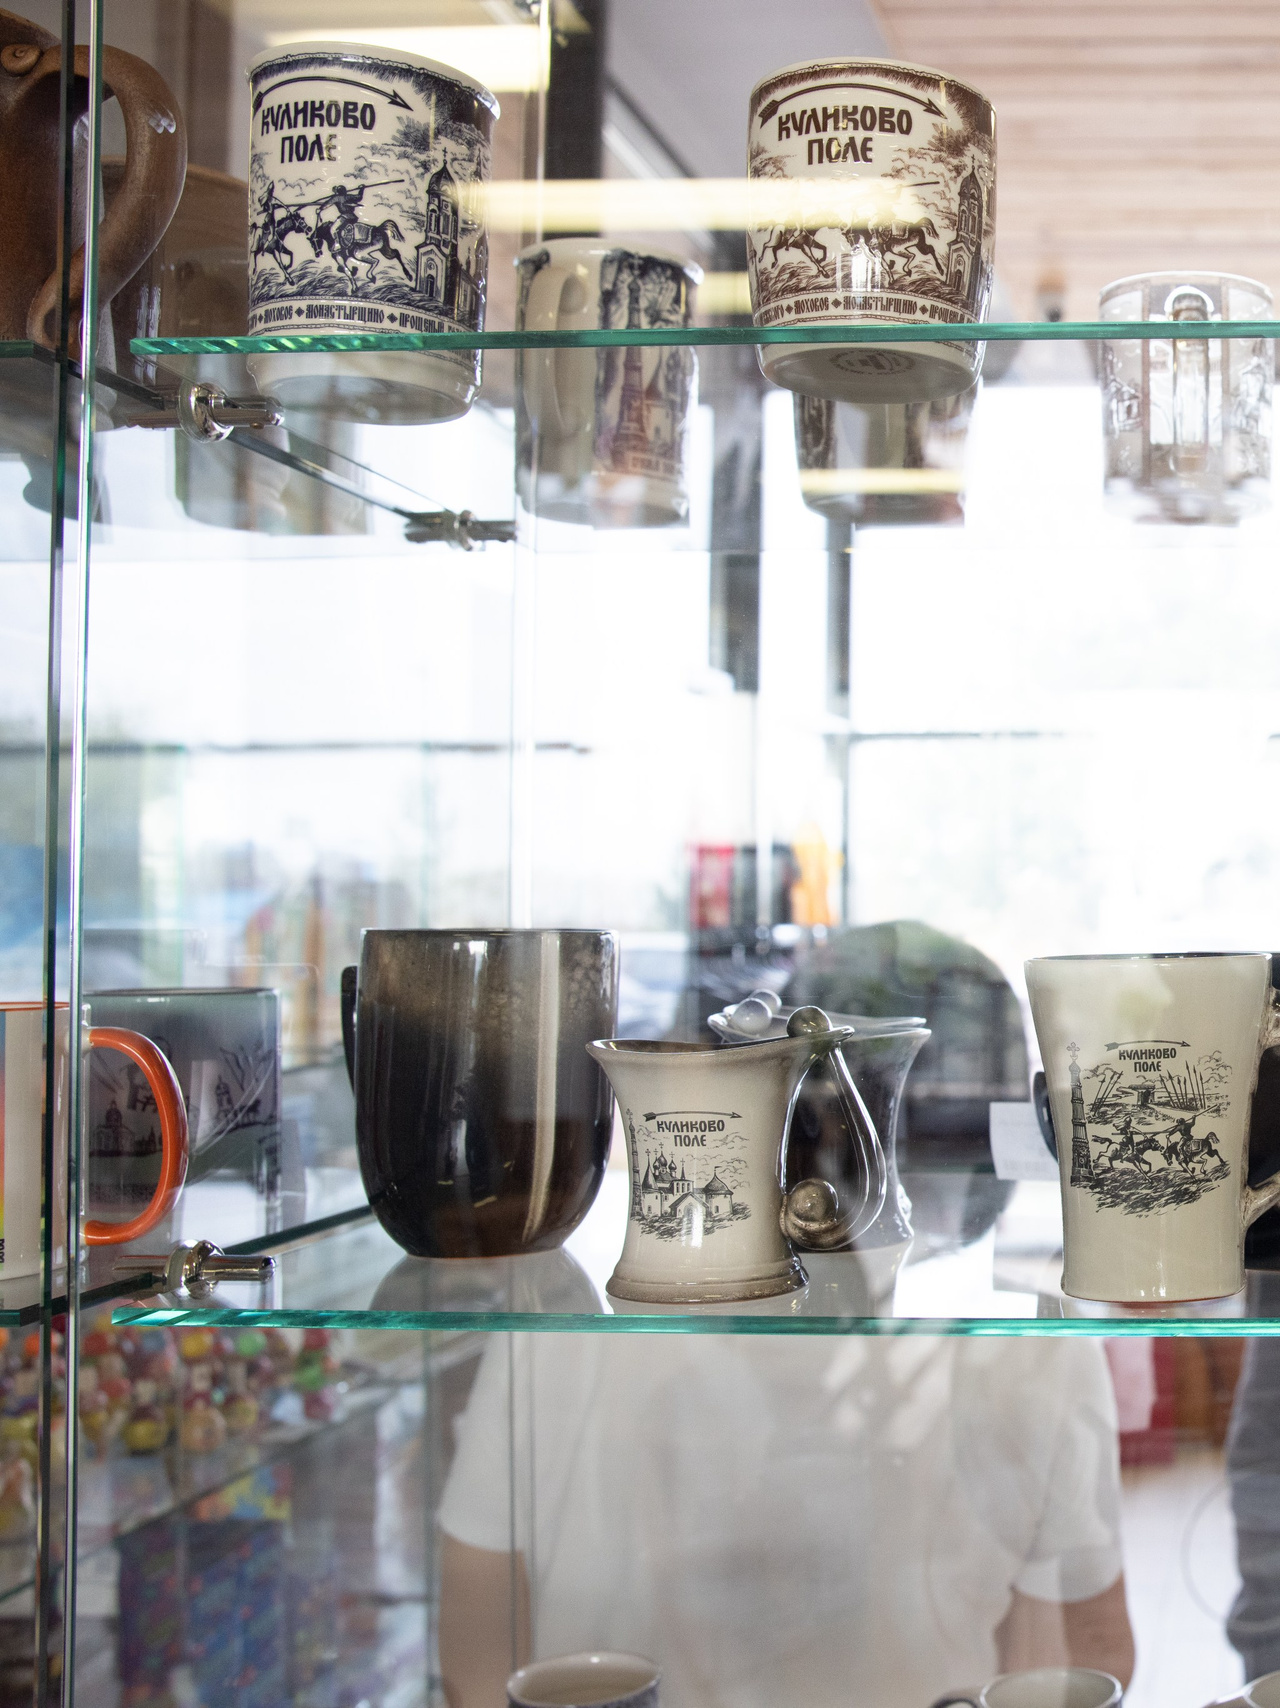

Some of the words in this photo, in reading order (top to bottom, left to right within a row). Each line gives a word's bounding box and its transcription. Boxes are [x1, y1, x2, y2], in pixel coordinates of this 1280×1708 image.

[260, 100, 376, 136] КУЛИКОВО
[778, 105, 913, 141] КУЛИКОВО
[281, 134, 338, 163] ПОЛЕ
[808, 136, 873, 165] ПОЛЕ
[1118, 1047, 1177, 1061] КУЛИКОВО
[1134, 1061, 1162, 1073] ПОЛЕ
[656, 1119, 725, 1133] КУЛИКОВО
[673, 1134, 707, 1147] ПОЛЕ
